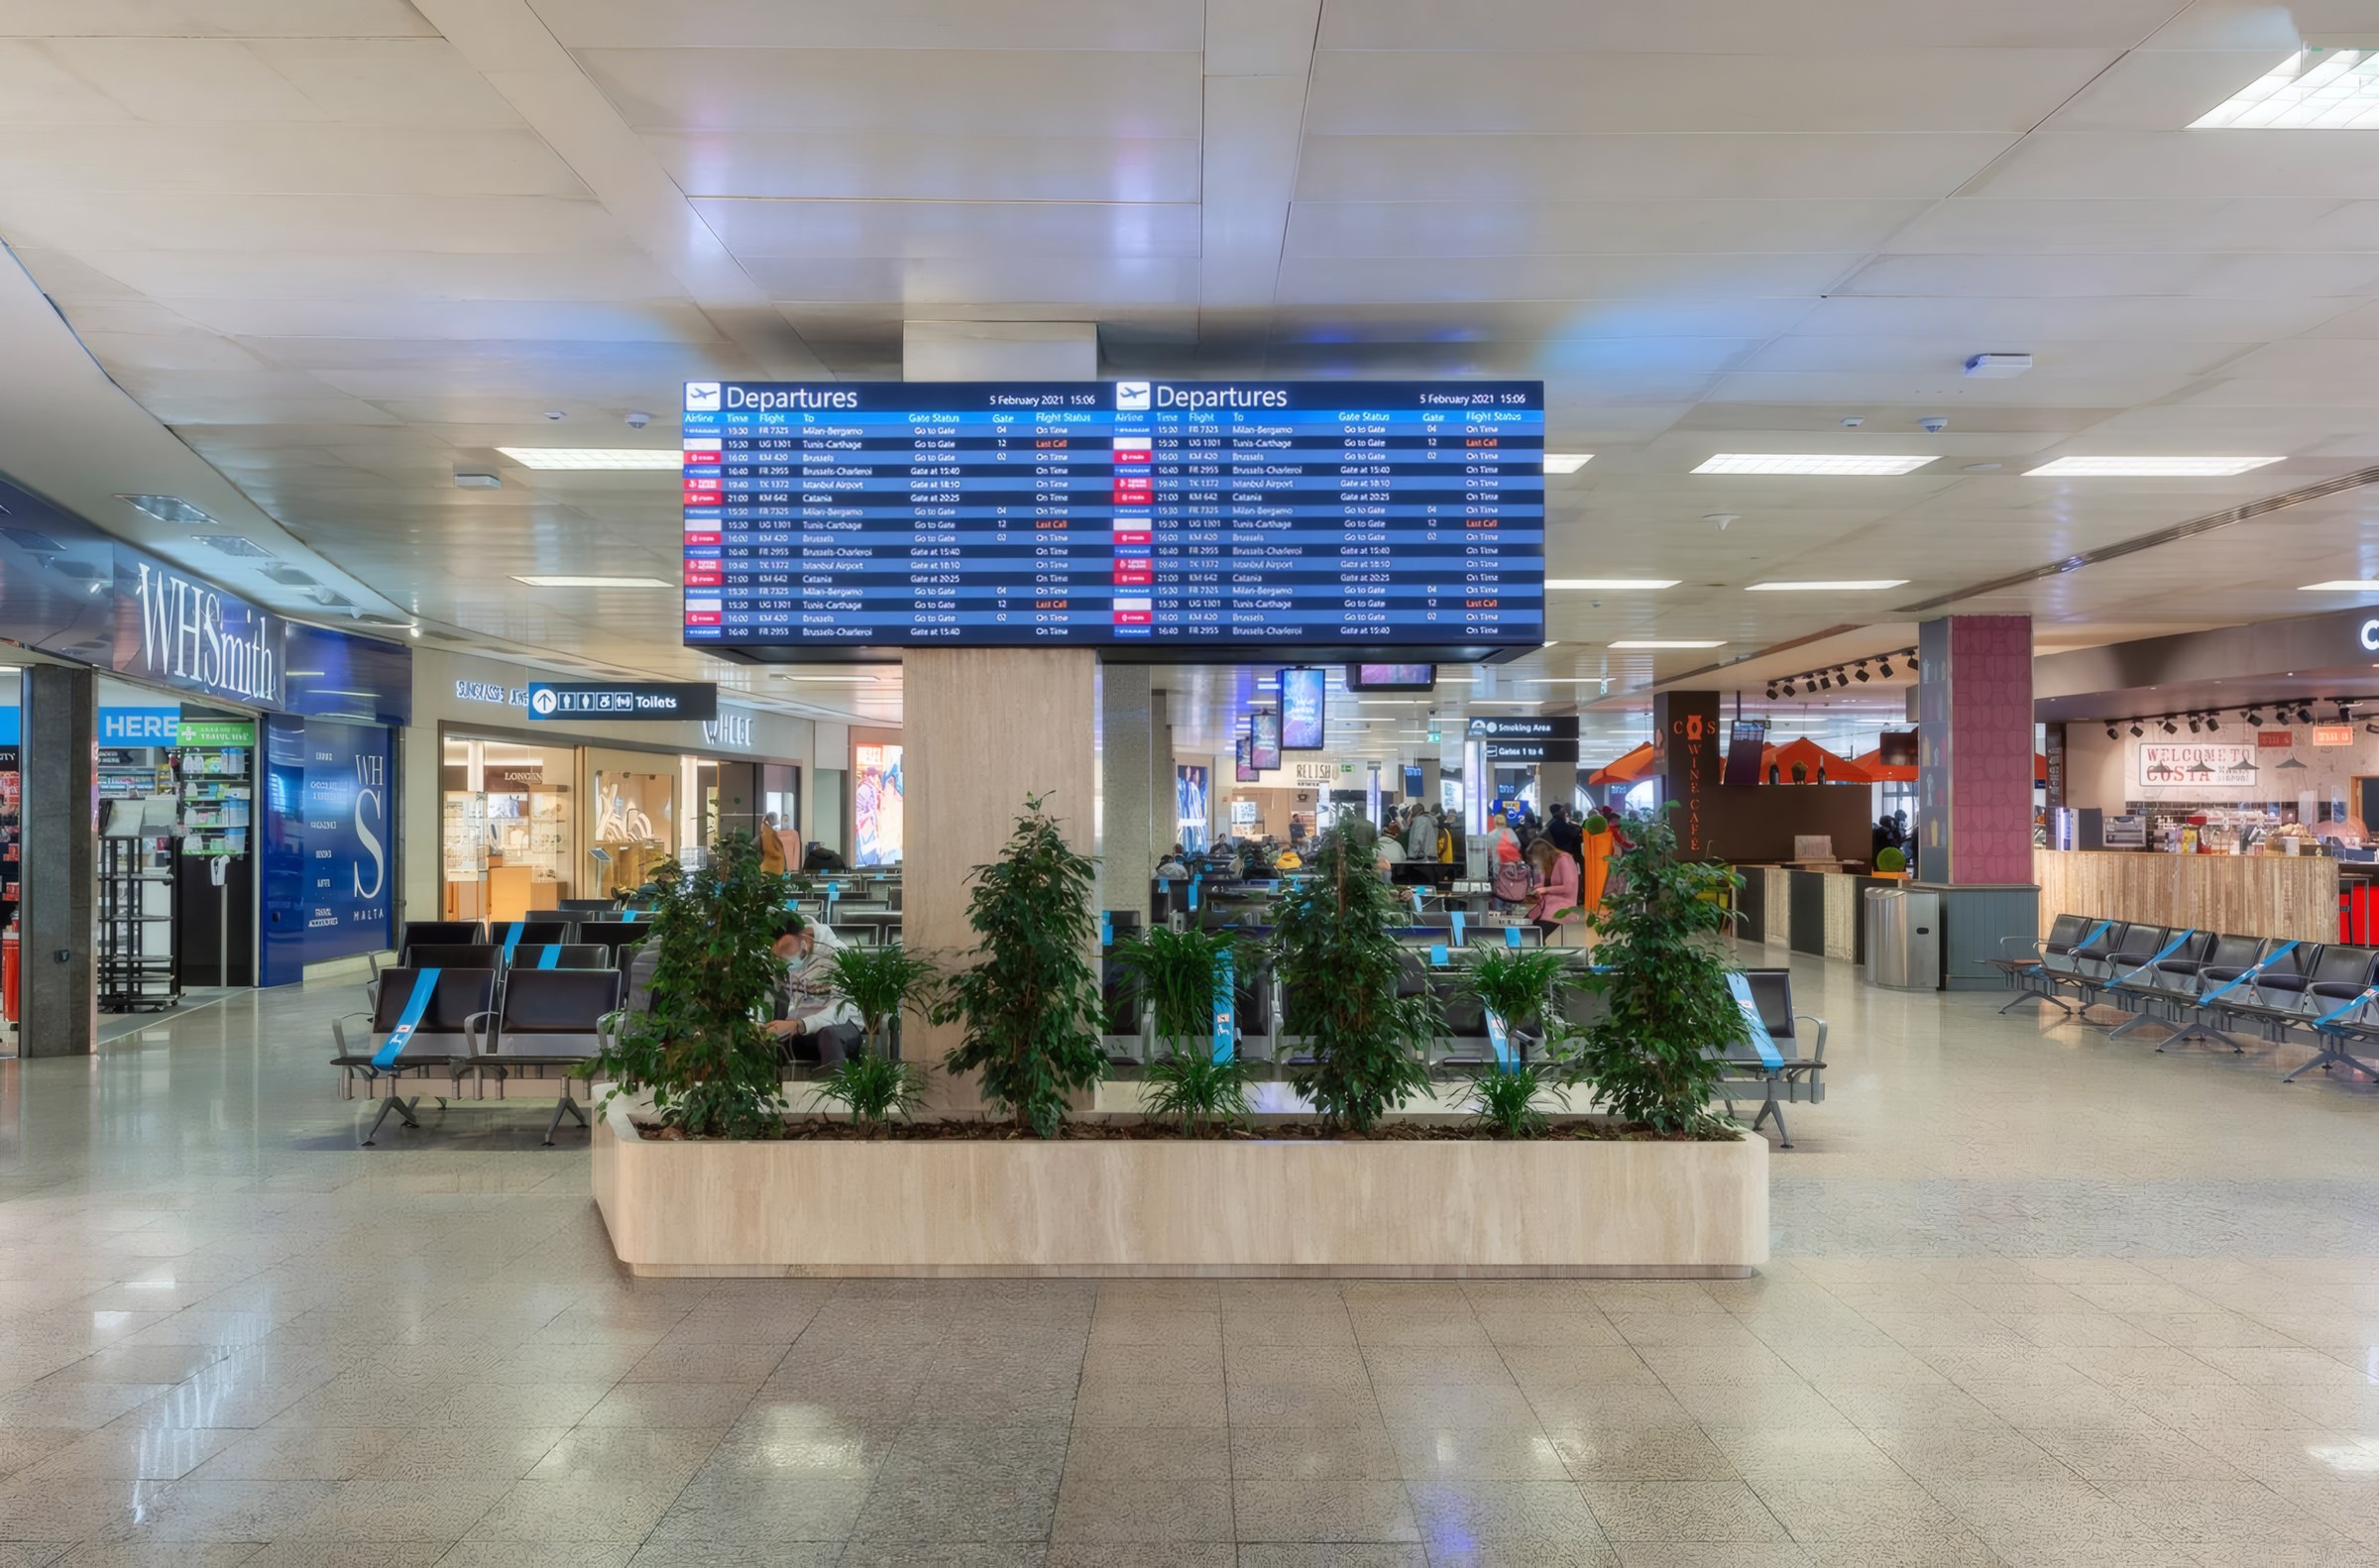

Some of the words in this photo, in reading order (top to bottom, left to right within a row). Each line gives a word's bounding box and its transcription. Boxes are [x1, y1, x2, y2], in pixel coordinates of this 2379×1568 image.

[727, 386, 858, 412] Departures
[989, 395, 996, 404] 5
[998, 395, 1039, 407] February
[1041, 395, 1064, 404] 2021
[1071, 395, 1095, 405] 15:06
[1157, 386, 1288, 411] Departures
[1419, 394, 1426, 404] 5
[1428, 394, 1469, 406] February
[1471, 394, 1494, 404] 2021
[1501, 394, 1526, 404] 15:06
[727, 414, 748, 423] Time
[758, 413, 785, 424] Flight
[803, 414, 815, 423] To
[908, 413, 930, 423] Gate
[932, 413, 960, 423] Status
[992, 414, 1014, 424] Gate
[1036, 412, 1062, 424] Flight
[1064, 412, 1091, 423] Status
[1157, 413, 1179, 422] Time
[1189, 413, 1214, 424] Flight
[1233, 413, 1244, 422] To
[1338, 412, 1360, 422] Gate
[1362, 412, 1390, 422] Status
[1421, 412, 1444, 422] Gate
[1466, 411, 1491, 423] Flight
[1493, 411, 1522, 421] Status
[914, 426, 926, 435] Go
[927, 426, 937, 435] to
[938, 426, 956, 435] Gate
[1036, 425, 1049, 435] On
[1050, 425, 1069, 435] Time
[1343, 425, 1356, 434] Go
[1357, 425, 1366, 434] to
[1367, 425, 1386, 434] Gate
[1466, 425, 1479, 434] On
[1480, 425, 1499, 434] Time
[802, 440, 862, 450] Tunis-Carthage
[1036, 439, 1052, 448] Last
[1053, 439, 1068, 448] Call
[1232, 438, 1292, 450] Tunis-Carthage
[1466, 438, 1482, 448] Last
[1483, 438, 1498, 448] Call
[802, 453, 835, 462] Brussels
[914, 453, 926, 462] Go
[927, 453, 937, 462] to
[938, 453, 956, 462] Gate
[1036, 452, 1049, 462] On
[1050, 452, 1069, 462] Time
[1232, 452, 1264, 461] Brussels
[910, 466, 929, 475] Gate
[930, 466, 939, 475] at
[1036, 465, 1049, 475] On
[1050, 465, 1069, 475] Time
[910, 480, 929, 489] Gate
[930, 480, 939, 489] at
[1036, 479, 1049, 489] On
[1050, 479, 1069, 489] Time
[802, 494, 833, 503] Catania
[910, 494, 929, 503] Gate
[930, 494, 939, 503] at
[1036, 493, 1049, 503] On
[1050, 493, 1069, 503] Time
[1232, 493, 1263, 502] Catania
[802, 520, 862, 531] Tunis-Carthage
[1232, 519, 1292, 530] Tunis-Carthage
[802, 533, 835, 542] Brussels
[1232, 532, 1264, 541] Brussels
[802, 574, 833, 583] Catania
[1232, 573, 1263, 582] Catania
[802, 601, 862, 611] Tunis-Carthage
[1232, 599, 1292, 611] Tunis-Carthage
[802, 614, 835, 622] Brussels
[1232, 613, 1264, 621] Brussels
[138, 562, 277, 702] WHSmith
[635, 695, 678, 709] Toilets
[105, 715, 179, 737] HERE
[1498, 724, 1531, 734] Smoking
[1532, 724, 1551, 732] Area
[1498, 747, 1521, 756] Gates
[2148, 748, 2226, 762] WELCOME
[355, 754, 385, 786] WH
[1297, 764, 1331, 779] RELISH
[353, 788, 385, 899] S
[353, 907, 385, 922] MALTA
